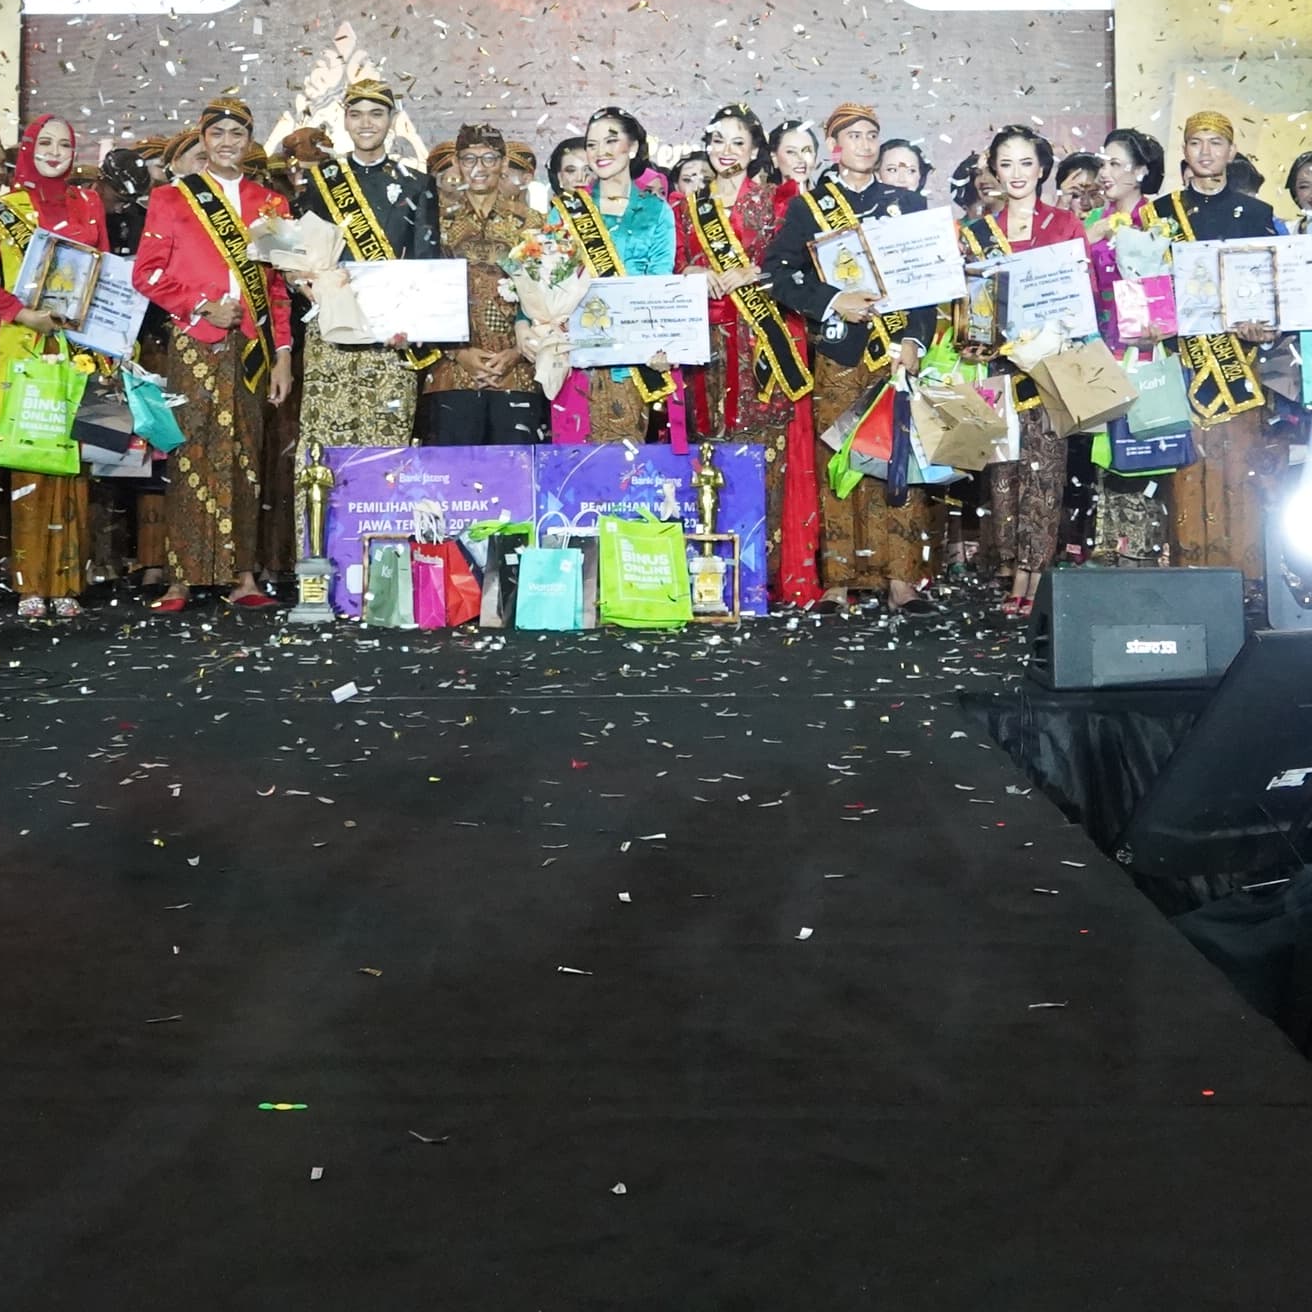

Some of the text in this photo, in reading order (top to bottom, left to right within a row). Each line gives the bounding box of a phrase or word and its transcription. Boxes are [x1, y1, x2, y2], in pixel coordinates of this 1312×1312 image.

[330, 182, 355, 210] MAS
[209, 208, 235, 237] MAS
[224, 236, 249, 269] JAWA
[587, 244, 615, 276] JAWA
[737, 283, 771, 322] ENGAH
[1221, 360, 1247, 383] 2024
[399, 473, 451, 485] Bank Jateng
[631, 476, 654, 486] Bank
[348, 501, 415, 513] PEMILIHAN
[451, 500, 489, 512] MBAK
[357, 519, 393, 533] JAWA
[622, 552, 670, 566] BINUS
[623, 563, 672, 576] ONLINE
